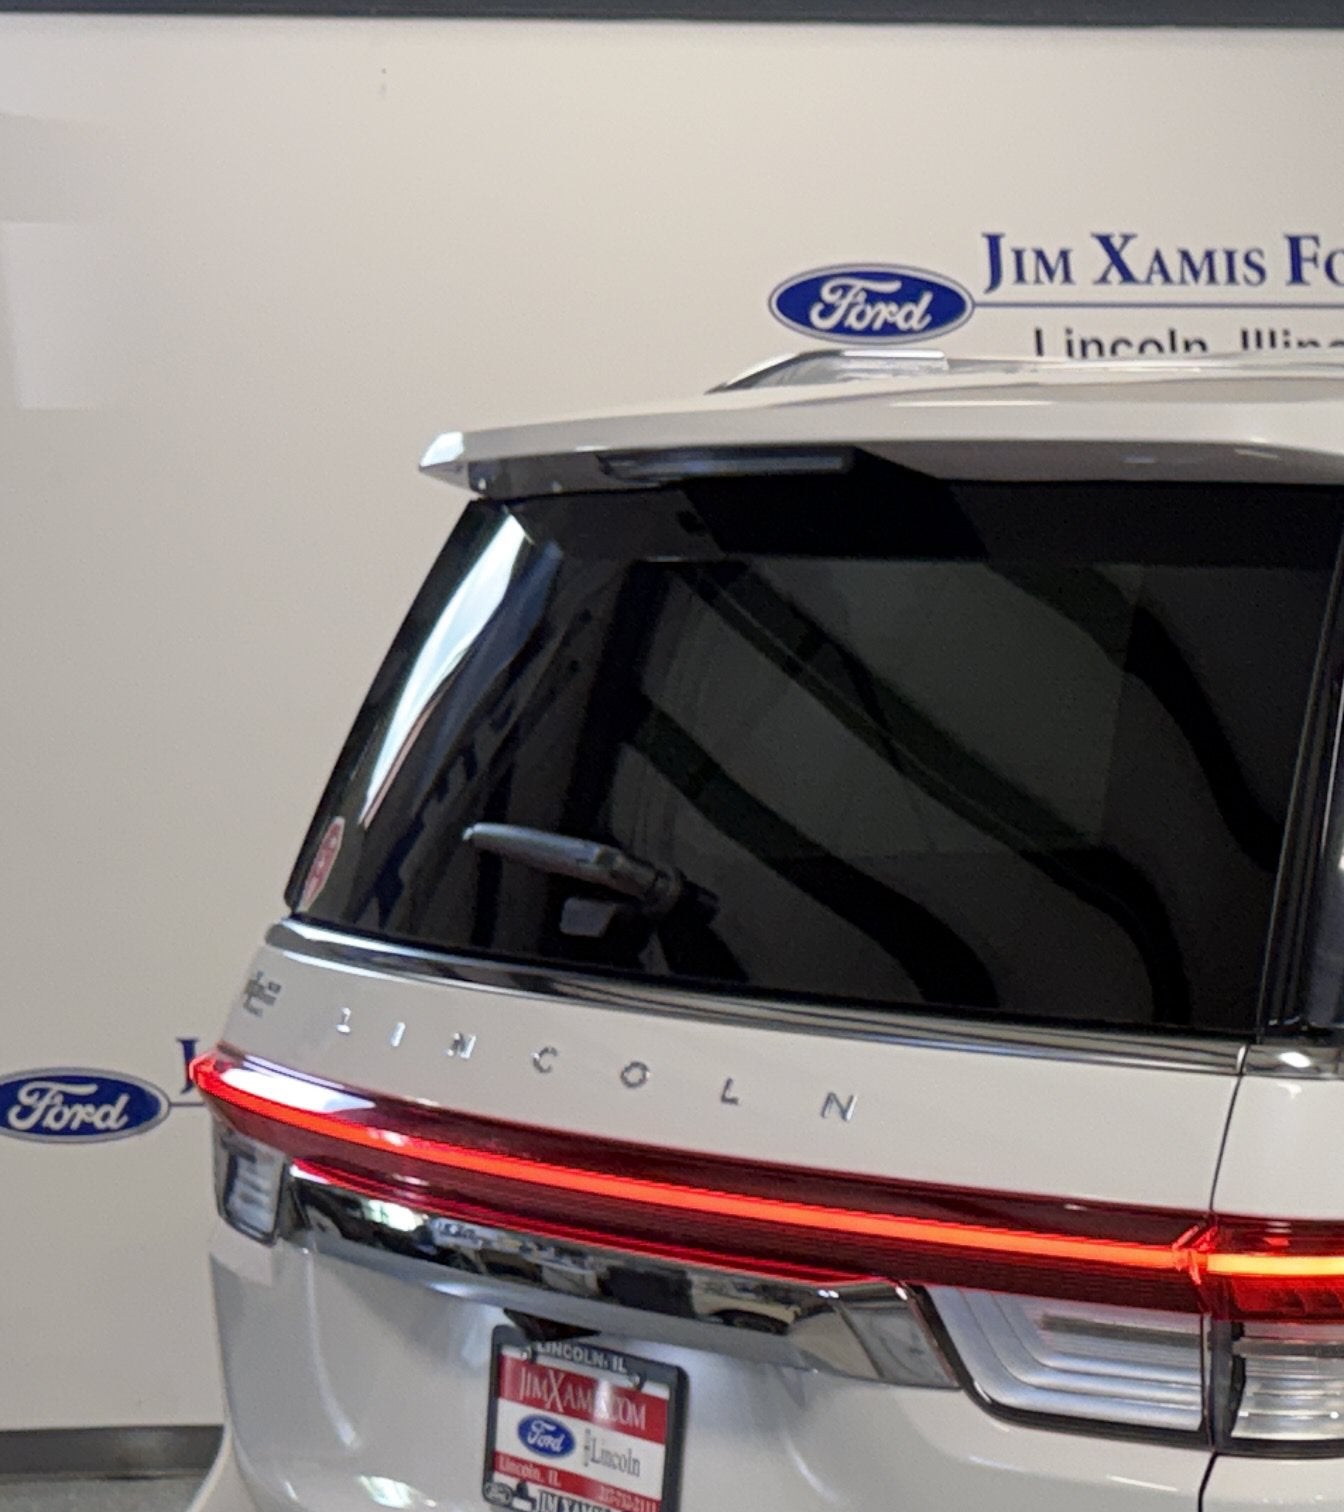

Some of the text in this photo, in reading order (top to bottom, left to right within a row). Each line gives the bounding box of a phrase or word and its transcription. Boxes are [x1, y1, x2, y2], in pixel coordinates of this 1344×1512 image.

[810, 277, 933, 330] Ford
[334, 1006, 858, 1121] LINCOLN
[7, 1081, 130, 1130] Ford
[527, 1419, 641, 1478] Ford Lincoln
